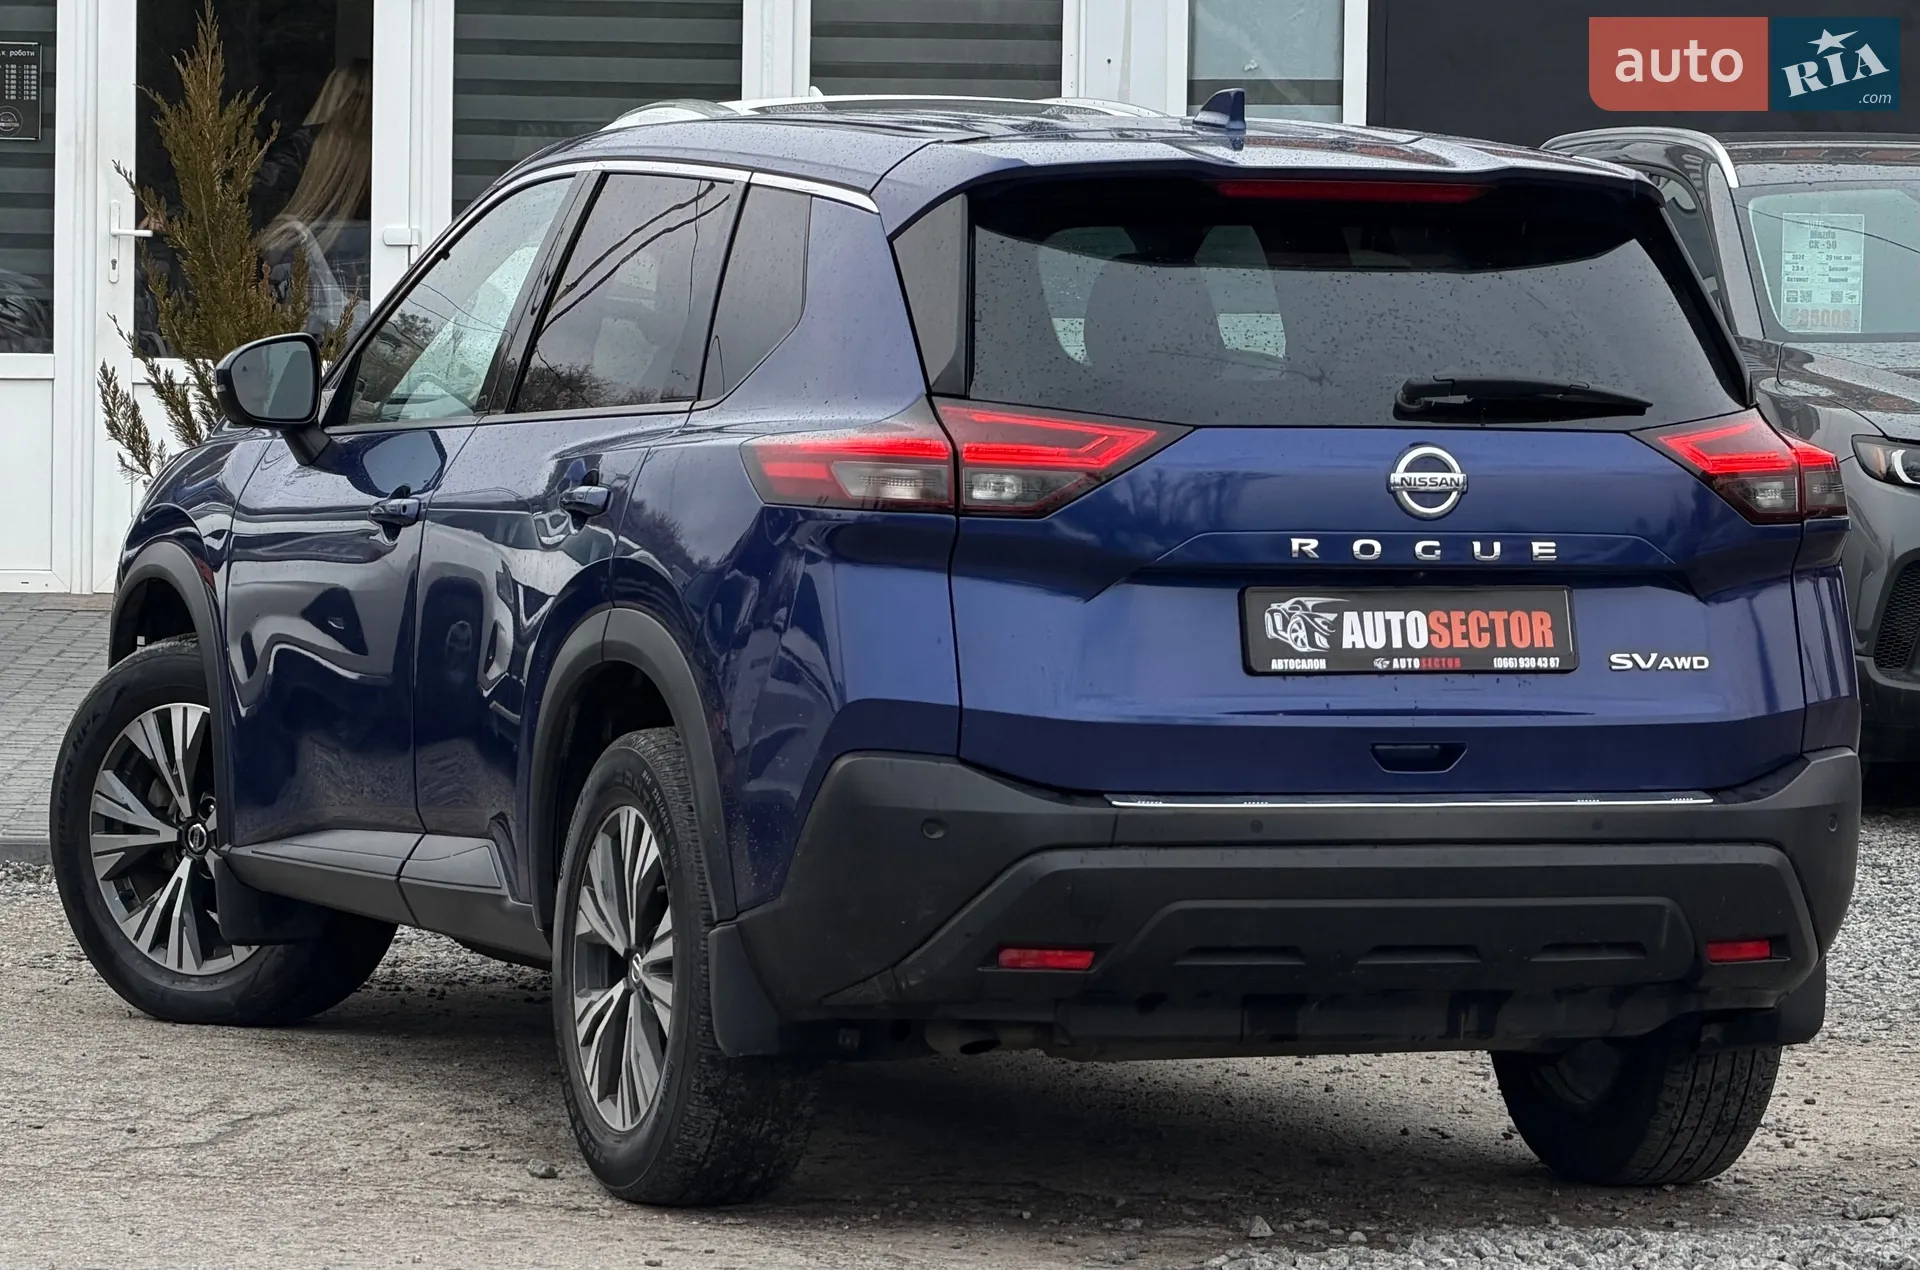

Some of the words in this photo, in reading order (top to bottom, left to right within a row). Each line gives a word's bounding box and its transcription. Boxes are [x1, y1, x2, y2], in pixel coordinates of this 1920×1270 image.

[9, 49, 35, 57] роботи
[1400, 476, 1461, 488] NISSAN
[1290, 538, 1558, 561] ROGUE
[1342, 610, 1555, 649] AUTOSECTOR
[1271, 658, 1327, 670] АВТОСАЛОН
[1493, 656, 1517, 668] (066)
[1518, 656, 1535, 668] 930
[1536, 656, 1548, 668] 43
[1549, 656, 1560, 668] 87
